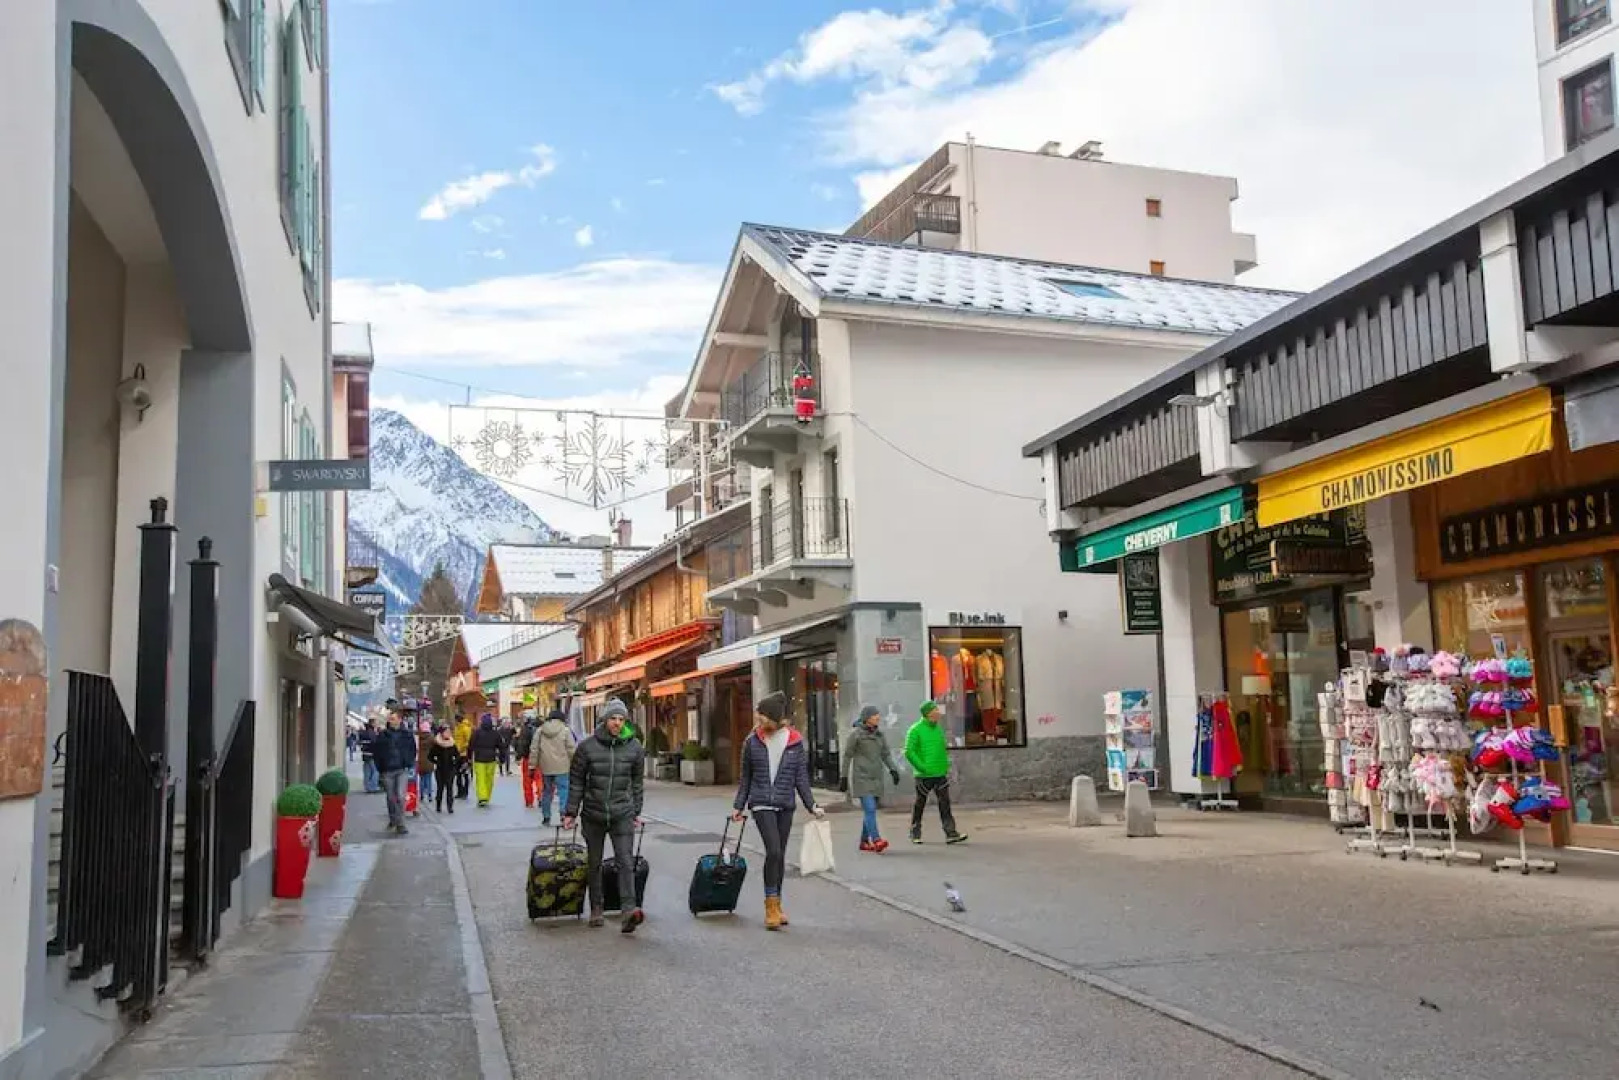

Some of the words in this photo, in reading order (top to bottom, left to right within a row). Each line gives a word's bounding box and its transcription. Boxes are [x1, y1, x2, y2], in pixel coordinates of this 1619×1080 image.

[292, 467, 366, 482] SWAROVSKI
[1320, 447, 1454, 509] CHAMONISSIMO
[1124, 521, 1178, 551] CHEVERNY
